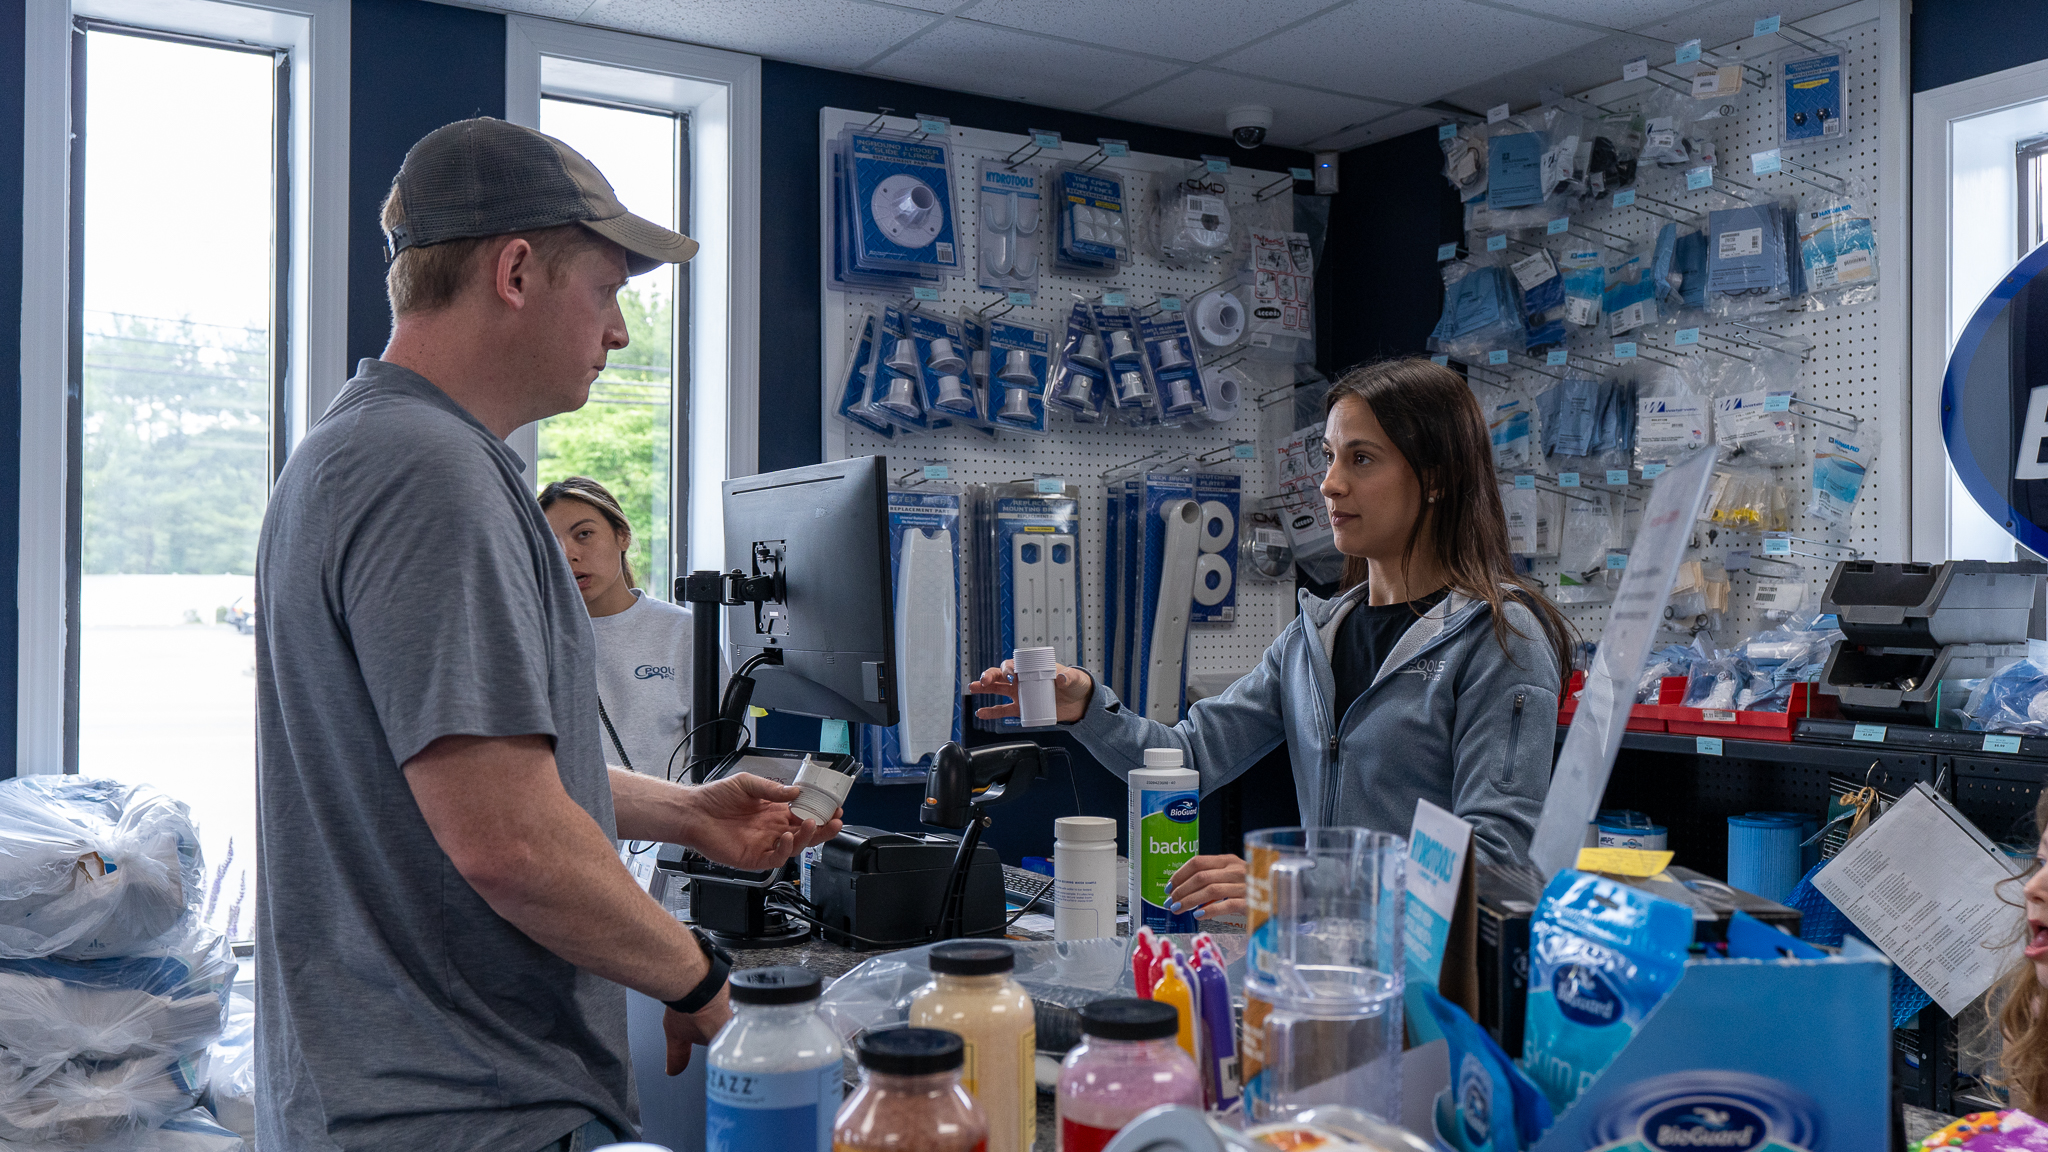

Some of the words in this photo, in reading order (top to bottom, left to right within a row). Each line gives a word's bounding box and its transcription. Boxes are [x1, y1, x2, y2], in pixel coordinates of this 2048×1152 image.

[856, 139, 901, 151] INGROUND
[904, 145, 940, 155] LADDER
[874, 146, 900, 156] SLIDE
[903, 150, 936, 161] FLANGE
[872, 155, 912, 164] REPLACEMENT
[986, 171, 1034, 188] HYDROTOOLS
[890, 494, 917, 504] STEP
[1170, 806, 1198, 817] BioGuard
[1149, 836, 1187, 855] back
[1656, 1123, 1756, 1148] BioGuard
